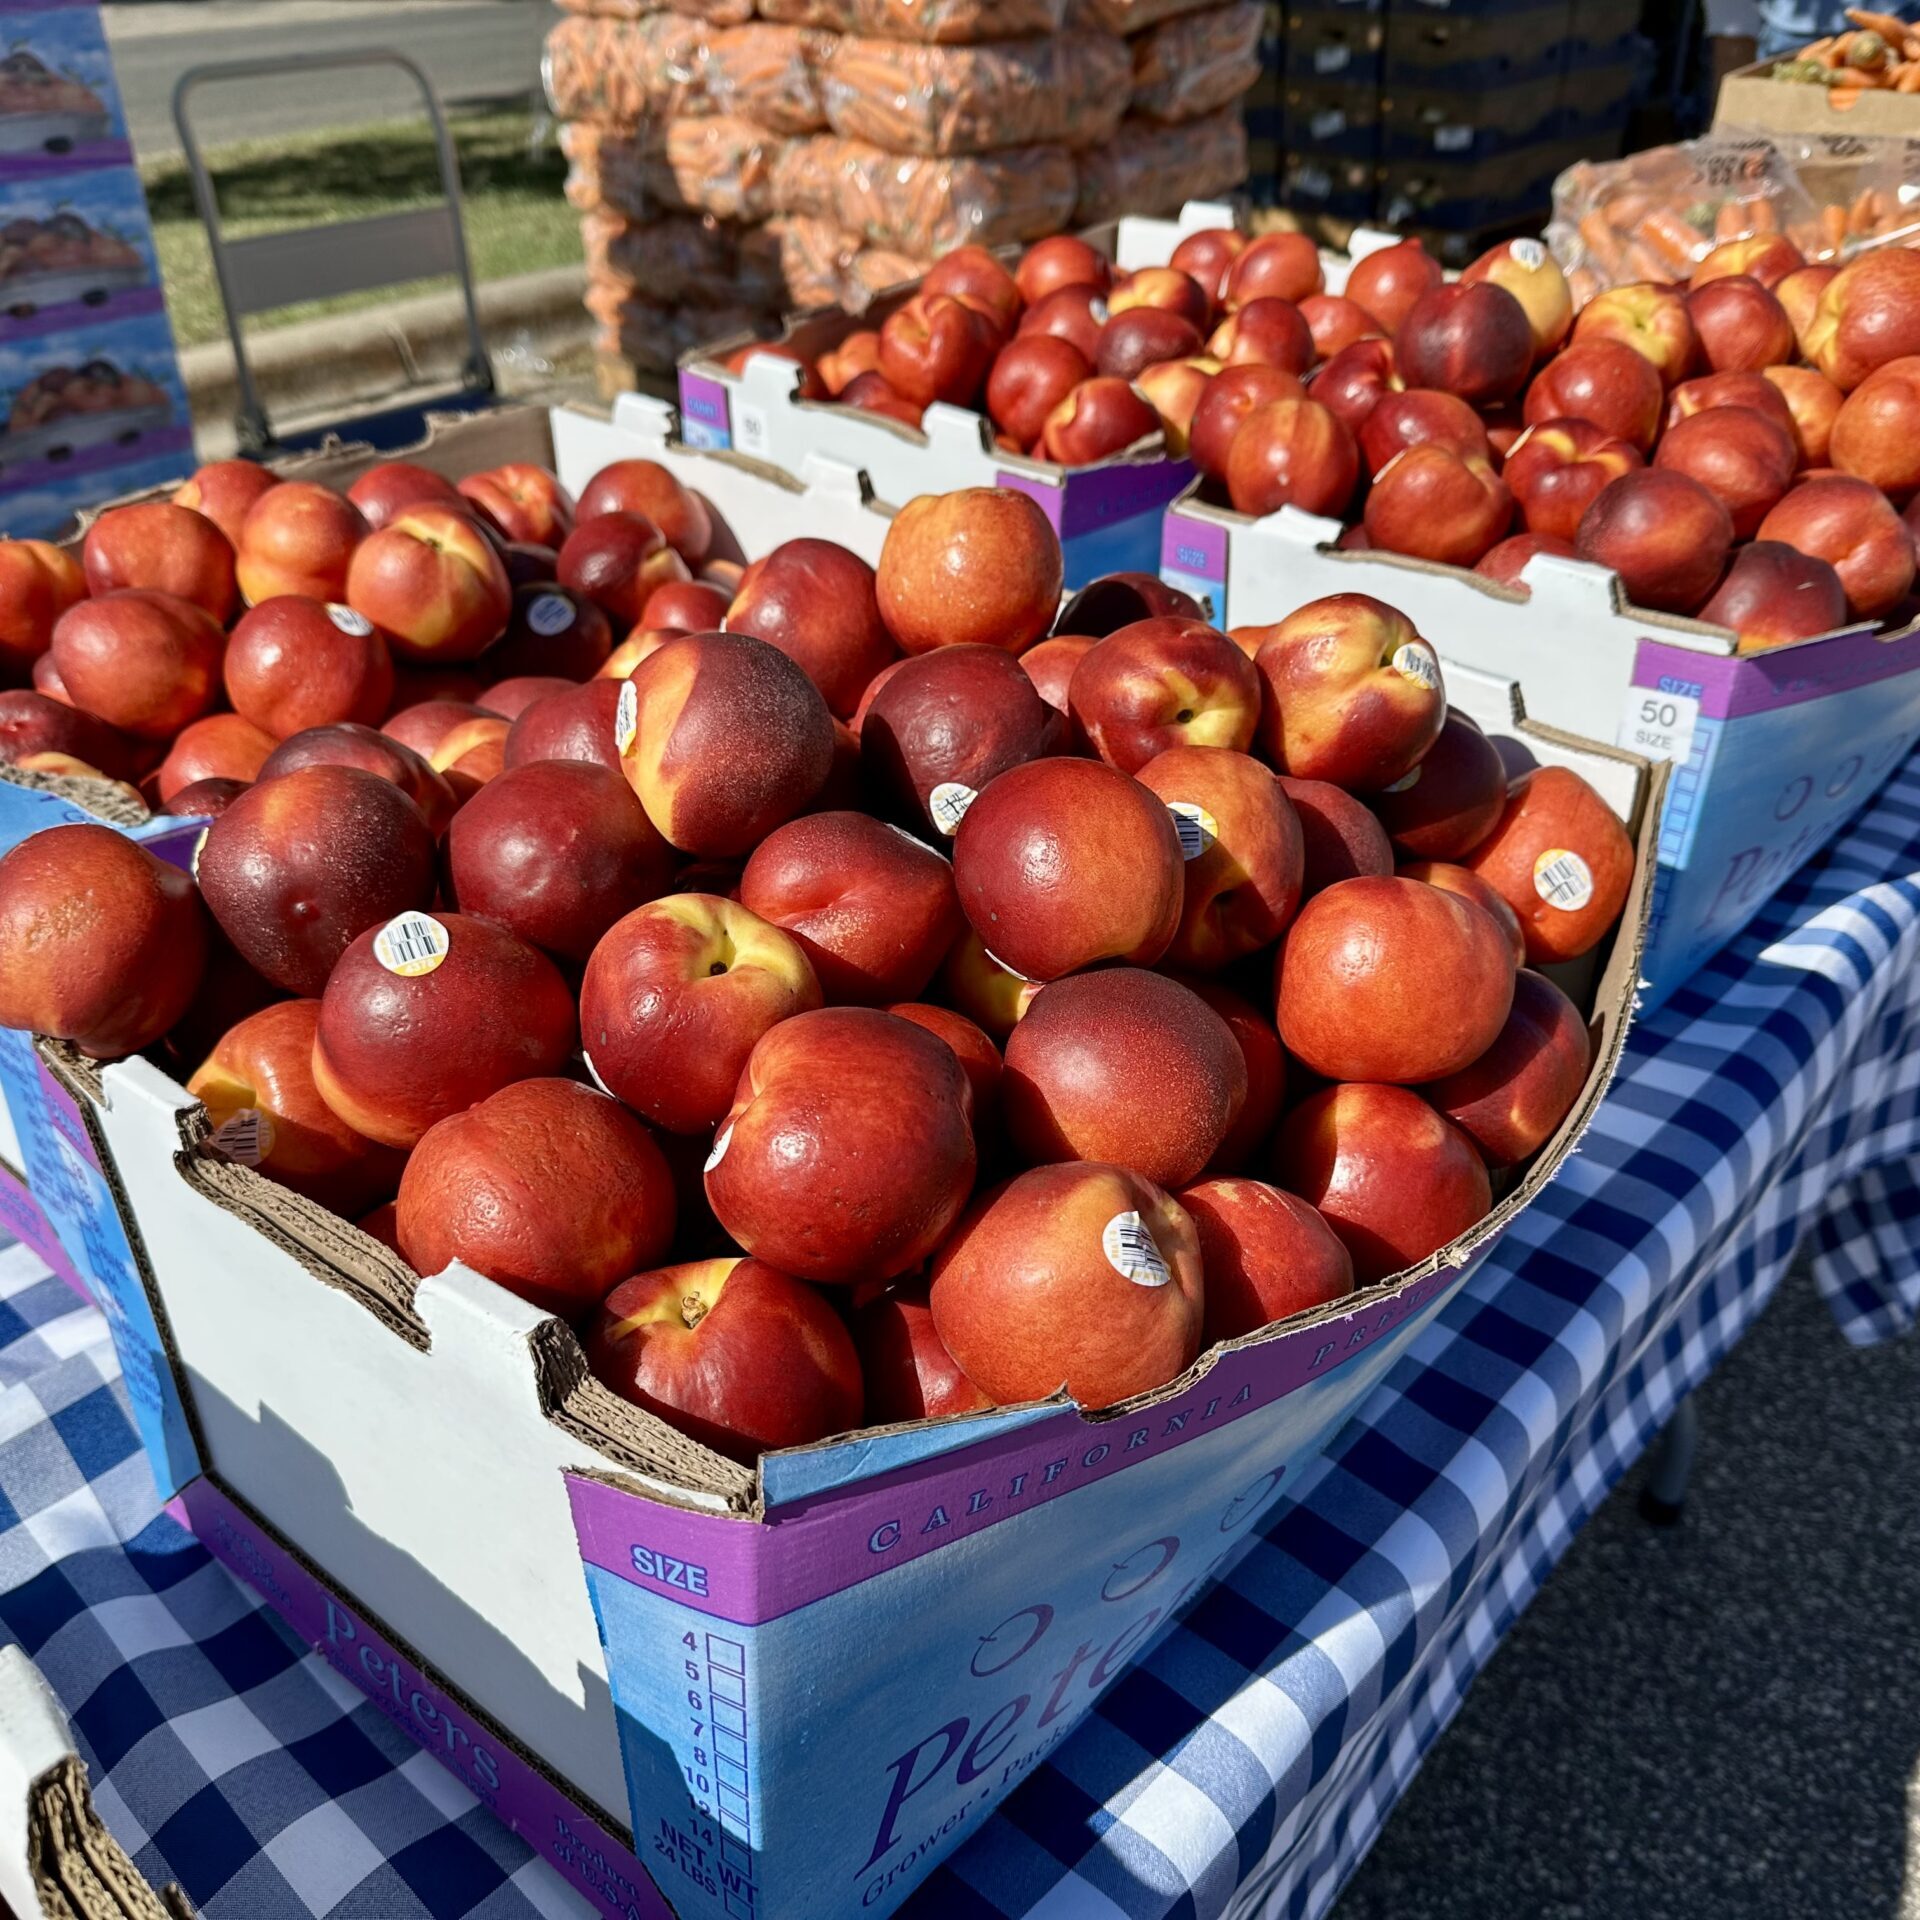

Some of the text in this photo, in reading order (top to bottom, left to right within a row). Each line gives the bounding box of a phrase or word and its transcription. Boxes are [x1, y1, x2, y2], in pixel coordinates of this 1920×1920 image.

[1659, 676, 1703, 697] SIZE
[1640, 700, 1677, 727] 50
[1634, 729, 1674, 751] SIZE
[868, 1383, 1253, 1554] CALIFORNIA
[631, 1544, 709, 1597] SIZE
[682, 1631, 698, 1651] 4
[685, 1659, 700, 1681] 5
[320, 1594, 500, 1790] Peters
[687, 1689, 703, 1711] 6
[689, 1716, 705, 1737] 7
[693, 1745, 708, 1767] 8
[684, 1764, 710, 1794] 10
[688, 1817, 714, 1848] 14
[552, 1841, 576, 1868] of
[553, 1814, 640, 1903] Product
[653, 1834, 718, 1898] 24 LBS
[862, 1800, 973, 1909] Grower
